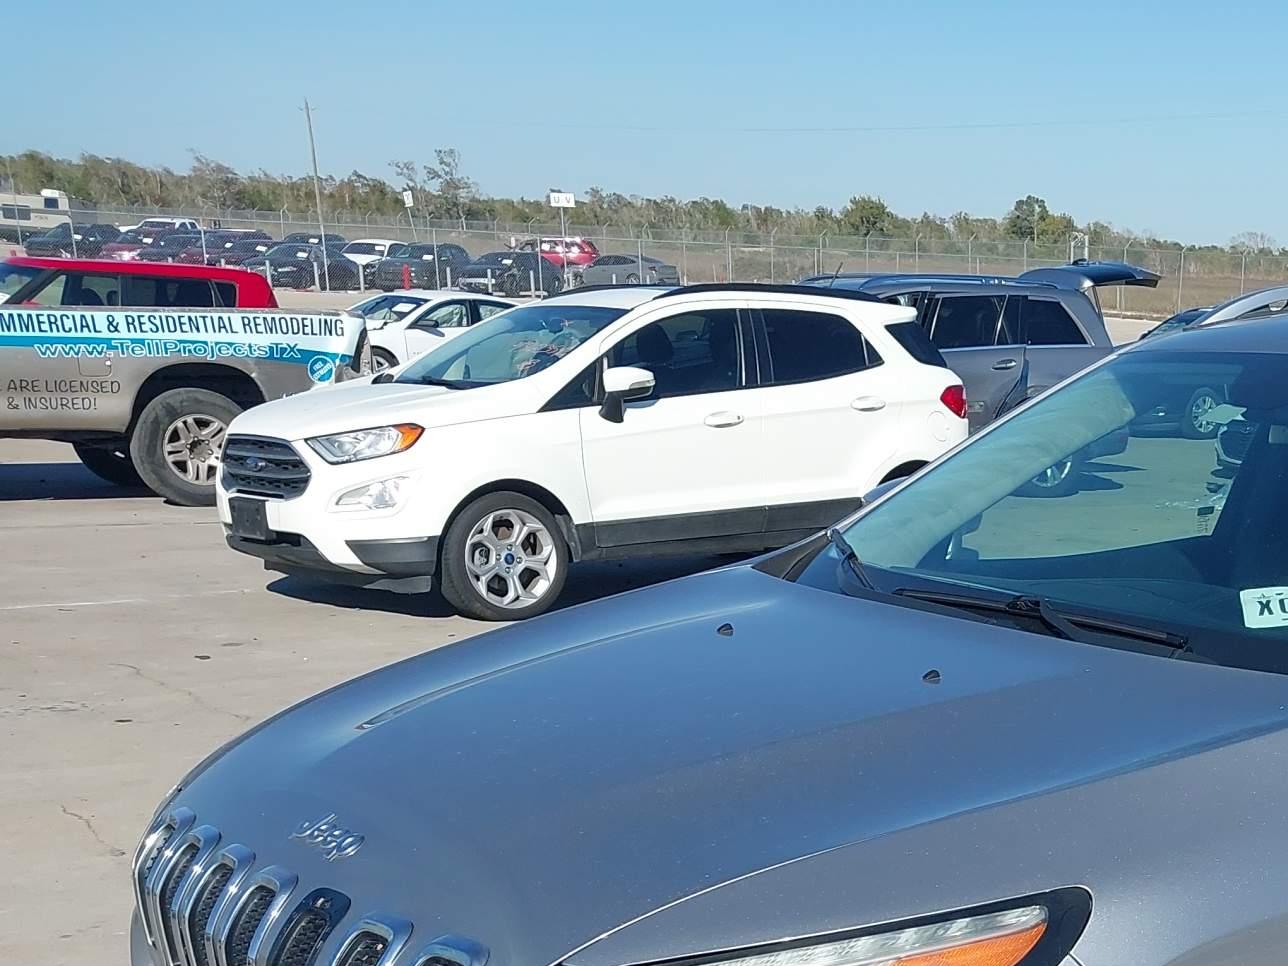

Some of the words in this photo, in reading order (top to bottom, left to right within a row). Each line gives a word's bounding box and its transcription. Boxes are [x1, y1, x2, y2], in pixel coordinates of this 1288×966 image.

[107, 314, 120, 333] &
[125, 314, 239, 335] RESIDENTIAL
[241, 315, 345, 337] REMODELING
[34, 339, 302, 360] www.TellProjectsTX
[7, 379, 41, 393] ARE
[45, 380, 121, 394] LICENSED
[7, 396, 20, 410] &
[23, 397, 98, 410] INSURED!
[288, 812, 366, 862] Jeep
